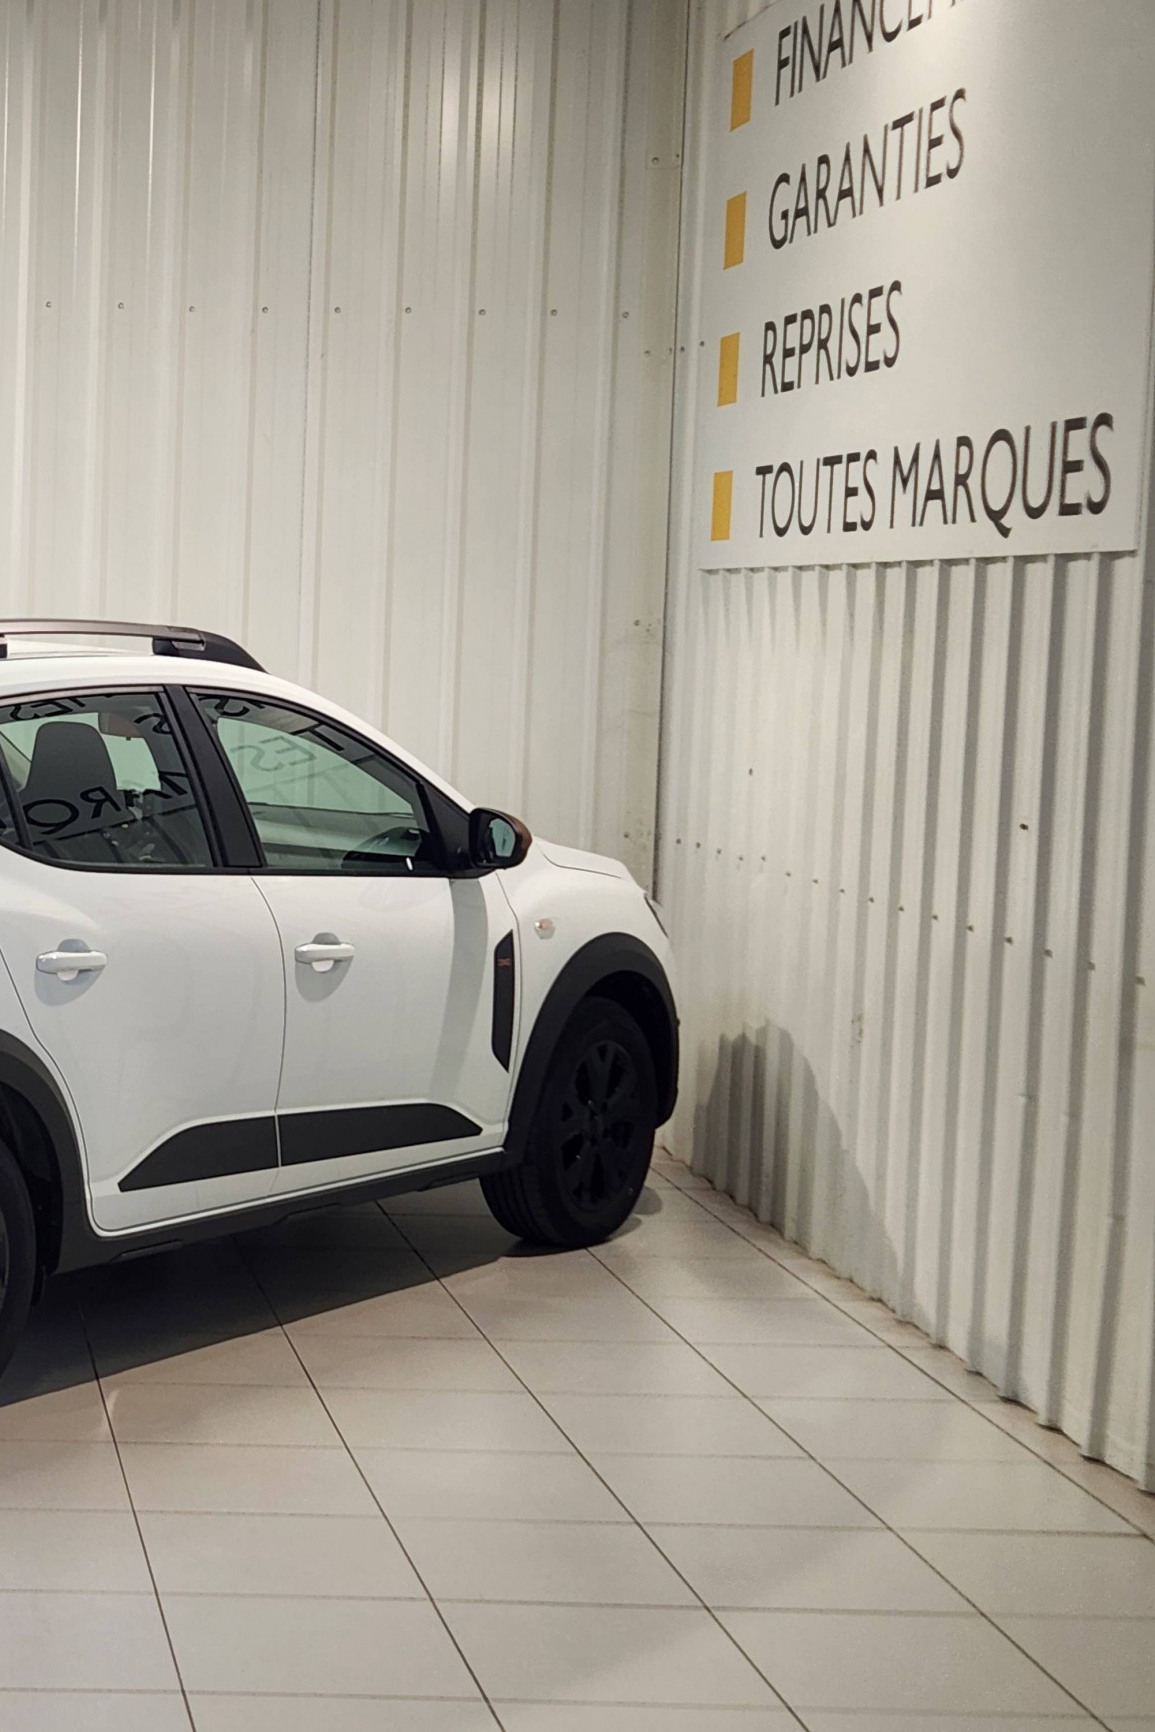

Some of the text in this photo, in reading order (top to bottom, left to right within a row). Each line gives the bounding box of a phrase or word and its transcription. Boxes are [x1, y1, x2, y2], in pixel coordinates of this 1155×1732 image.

[767, 87, 967, 250] GARANTIES
[760, 280, 903, 398] REPRISES
[755, 412, 1115, 538] TOUTES MARQUES
